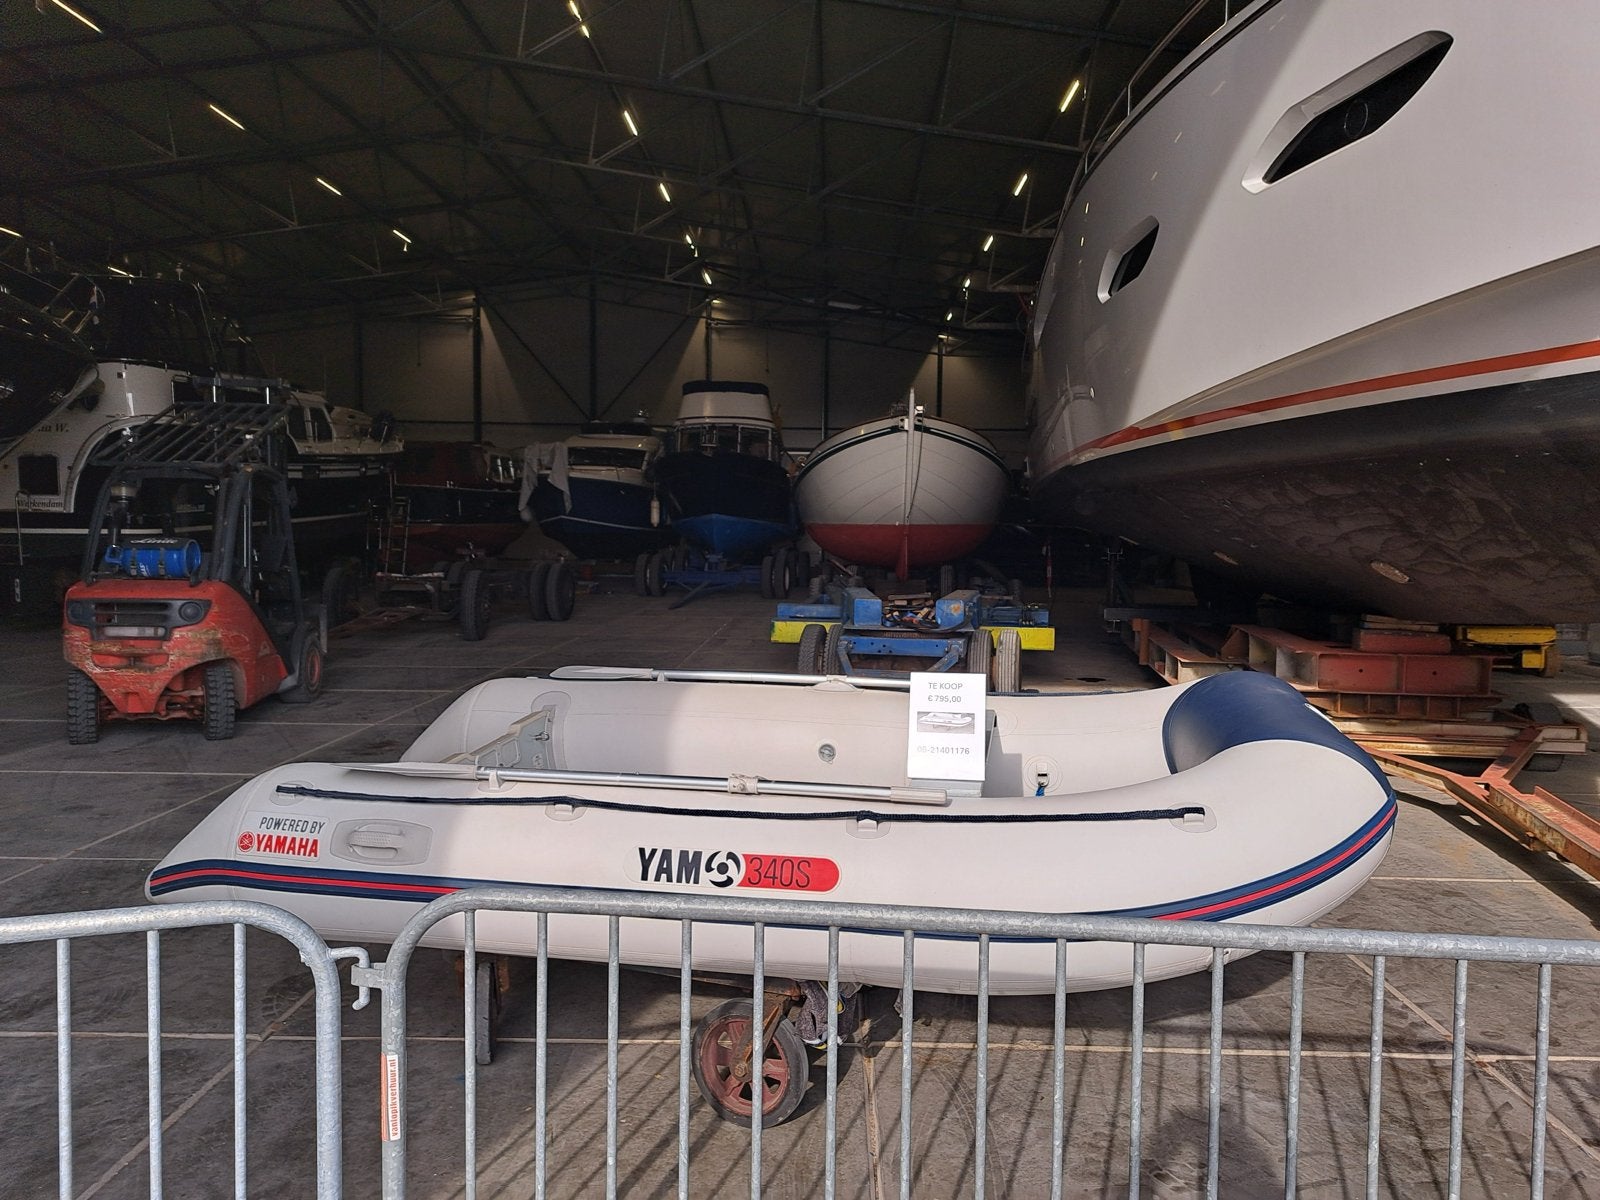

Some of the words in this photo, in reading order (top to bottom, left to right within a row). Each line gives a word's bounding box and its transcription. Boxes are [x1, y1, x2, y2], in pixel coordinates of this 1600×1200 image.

[928, 682, 938, 690] TE
[939, 682, 963, 690] KOOP
[935, 695, 962, 703] 795,00
[259, 816, 310, 833] POWERED
[309, 820, 326, 834] BY
[256, 833, 319, 858] YAMAHA
[638, 847, 703, 885] YAM
[747, 856, 812, 889] 340S
[388, 1058, 399, 1137] vanlopikverhuur.nl
